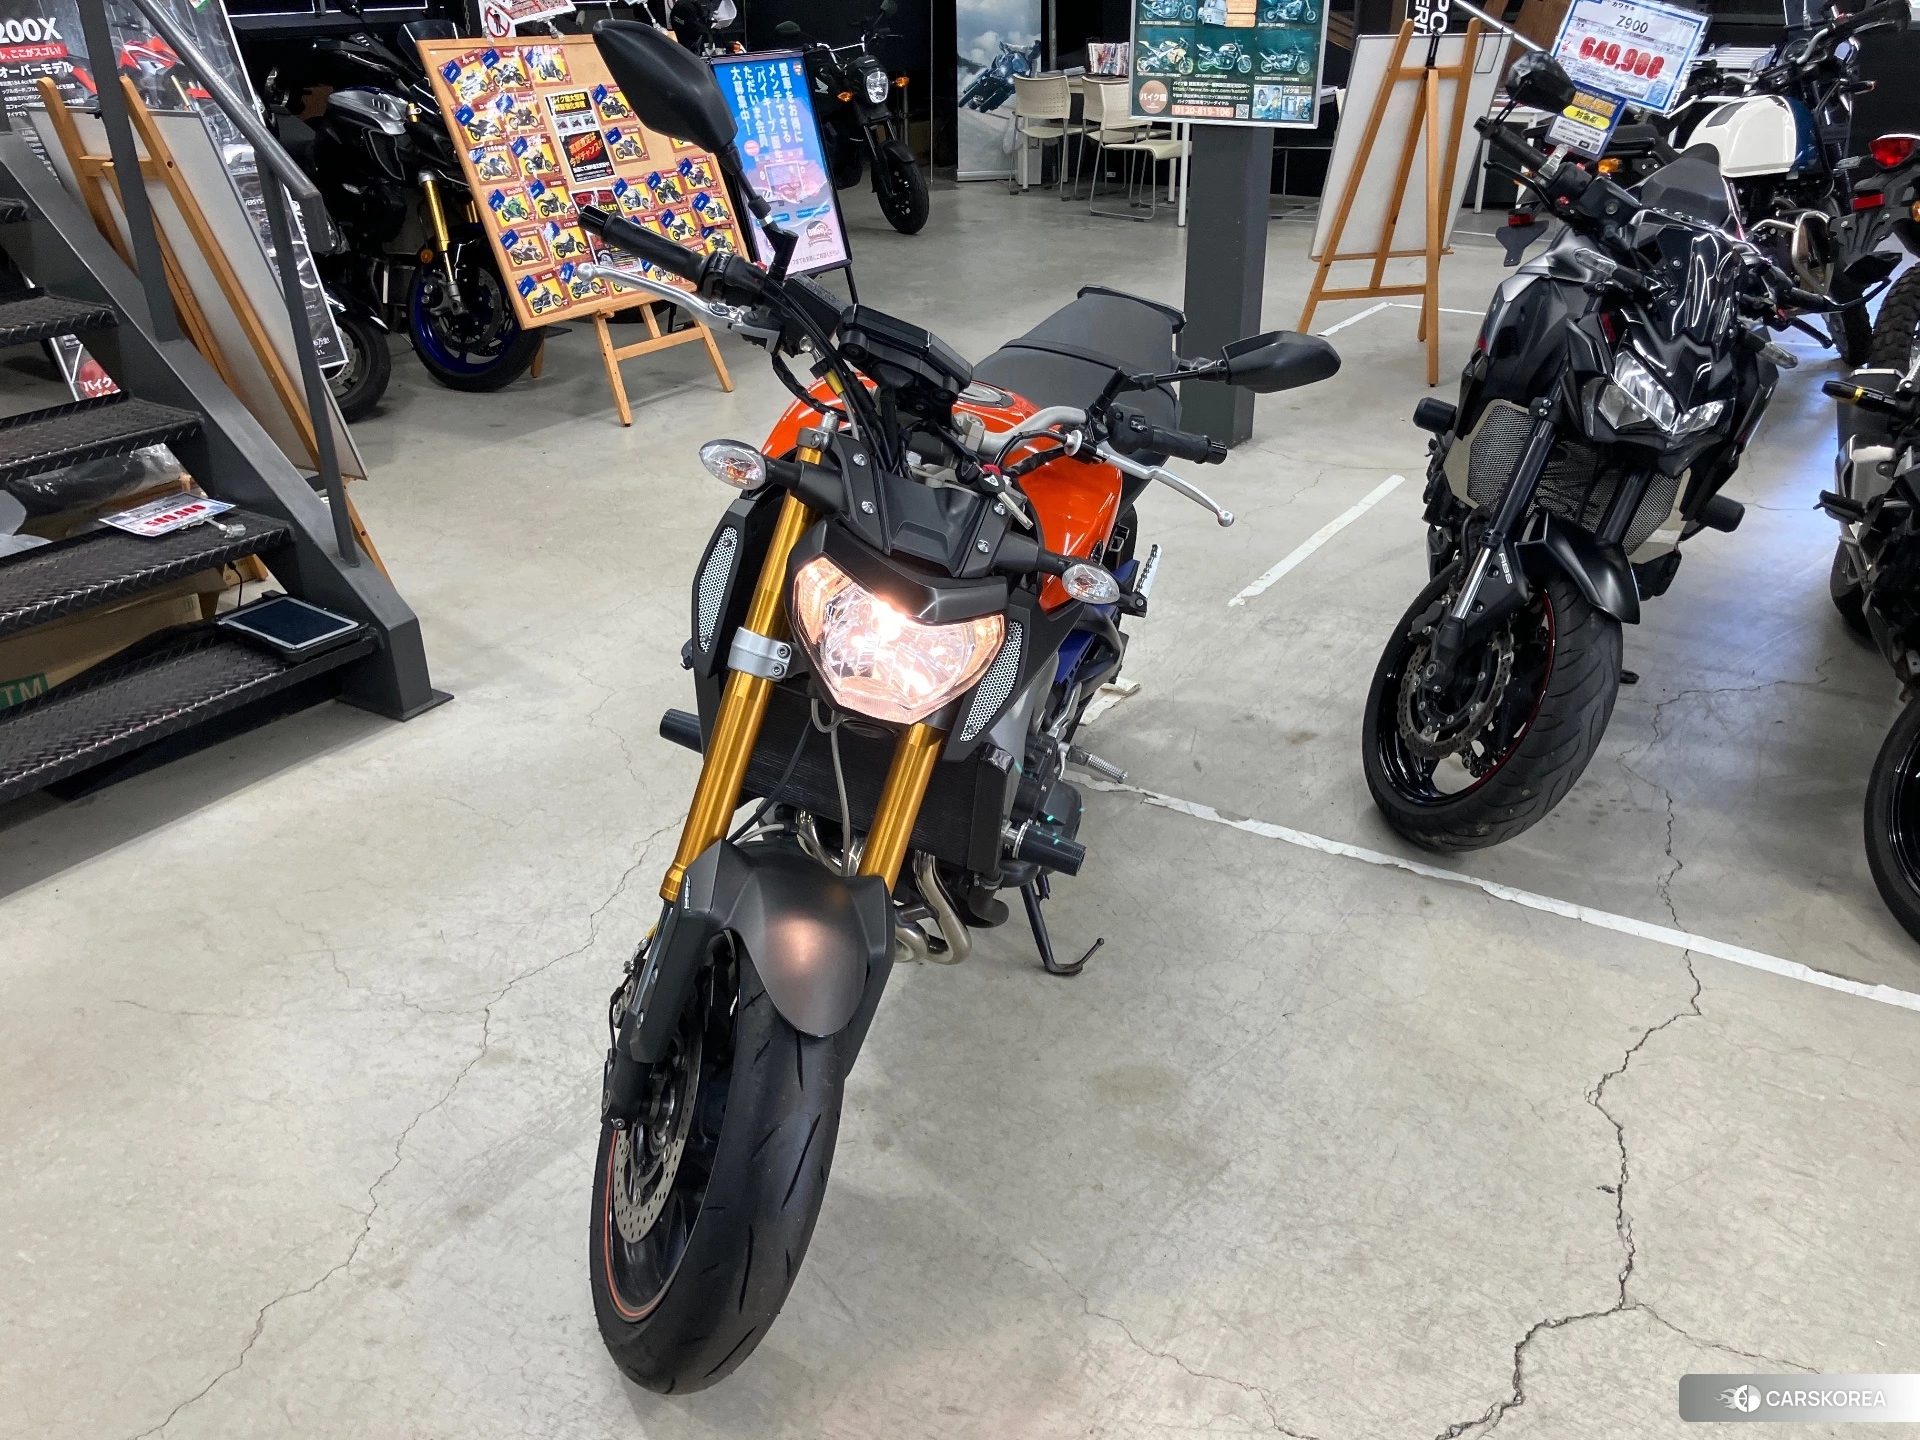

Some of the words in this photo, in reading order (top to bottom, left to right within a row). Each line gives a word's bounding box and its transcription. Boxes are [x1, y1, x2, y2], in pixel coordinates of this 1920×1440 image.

[1615, 15, 1649, 34] Z900
[1578, 36, 1665, 80] 649,900
[742, 65, 769, 148] ただいま会員
[768, 64, 791, 143] メンテできる
[1140, 92, 1167, 102] バイク館
[1174, 106, 1231, 117] 0120-819-106
[83, 376, 116, 392] バイク
[1498, 552, 1513, 585] ABS
